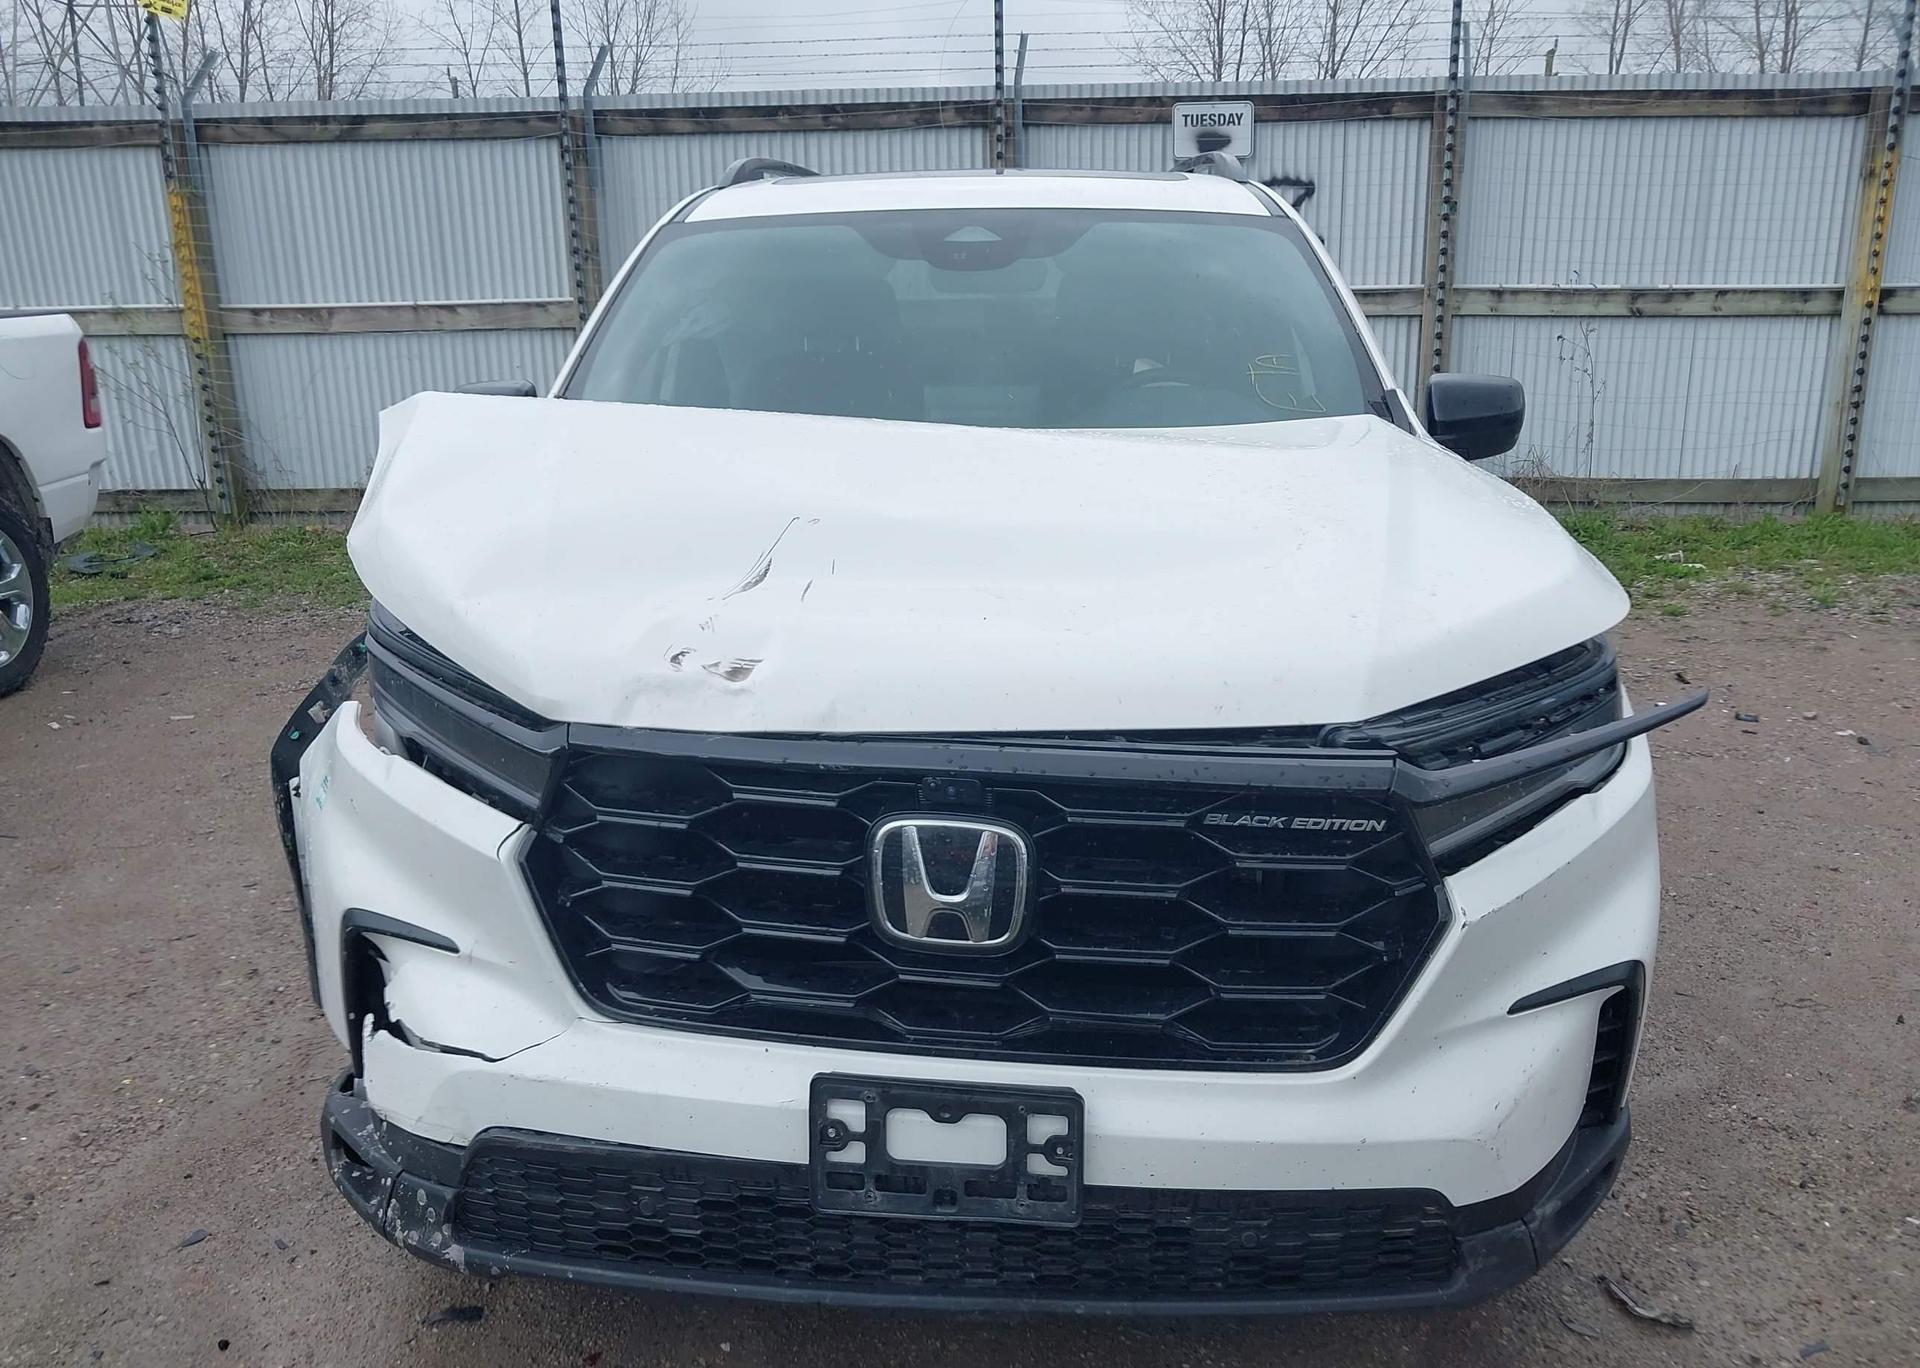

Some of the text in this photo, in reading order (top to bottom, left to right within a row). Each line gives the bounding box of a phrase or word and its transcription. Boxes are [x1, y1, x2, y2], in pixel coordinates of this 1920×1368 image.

[1182, 112, 1244, 129] TUESDAY
[1203, 813, 1387, 832] BLACK EDITION
